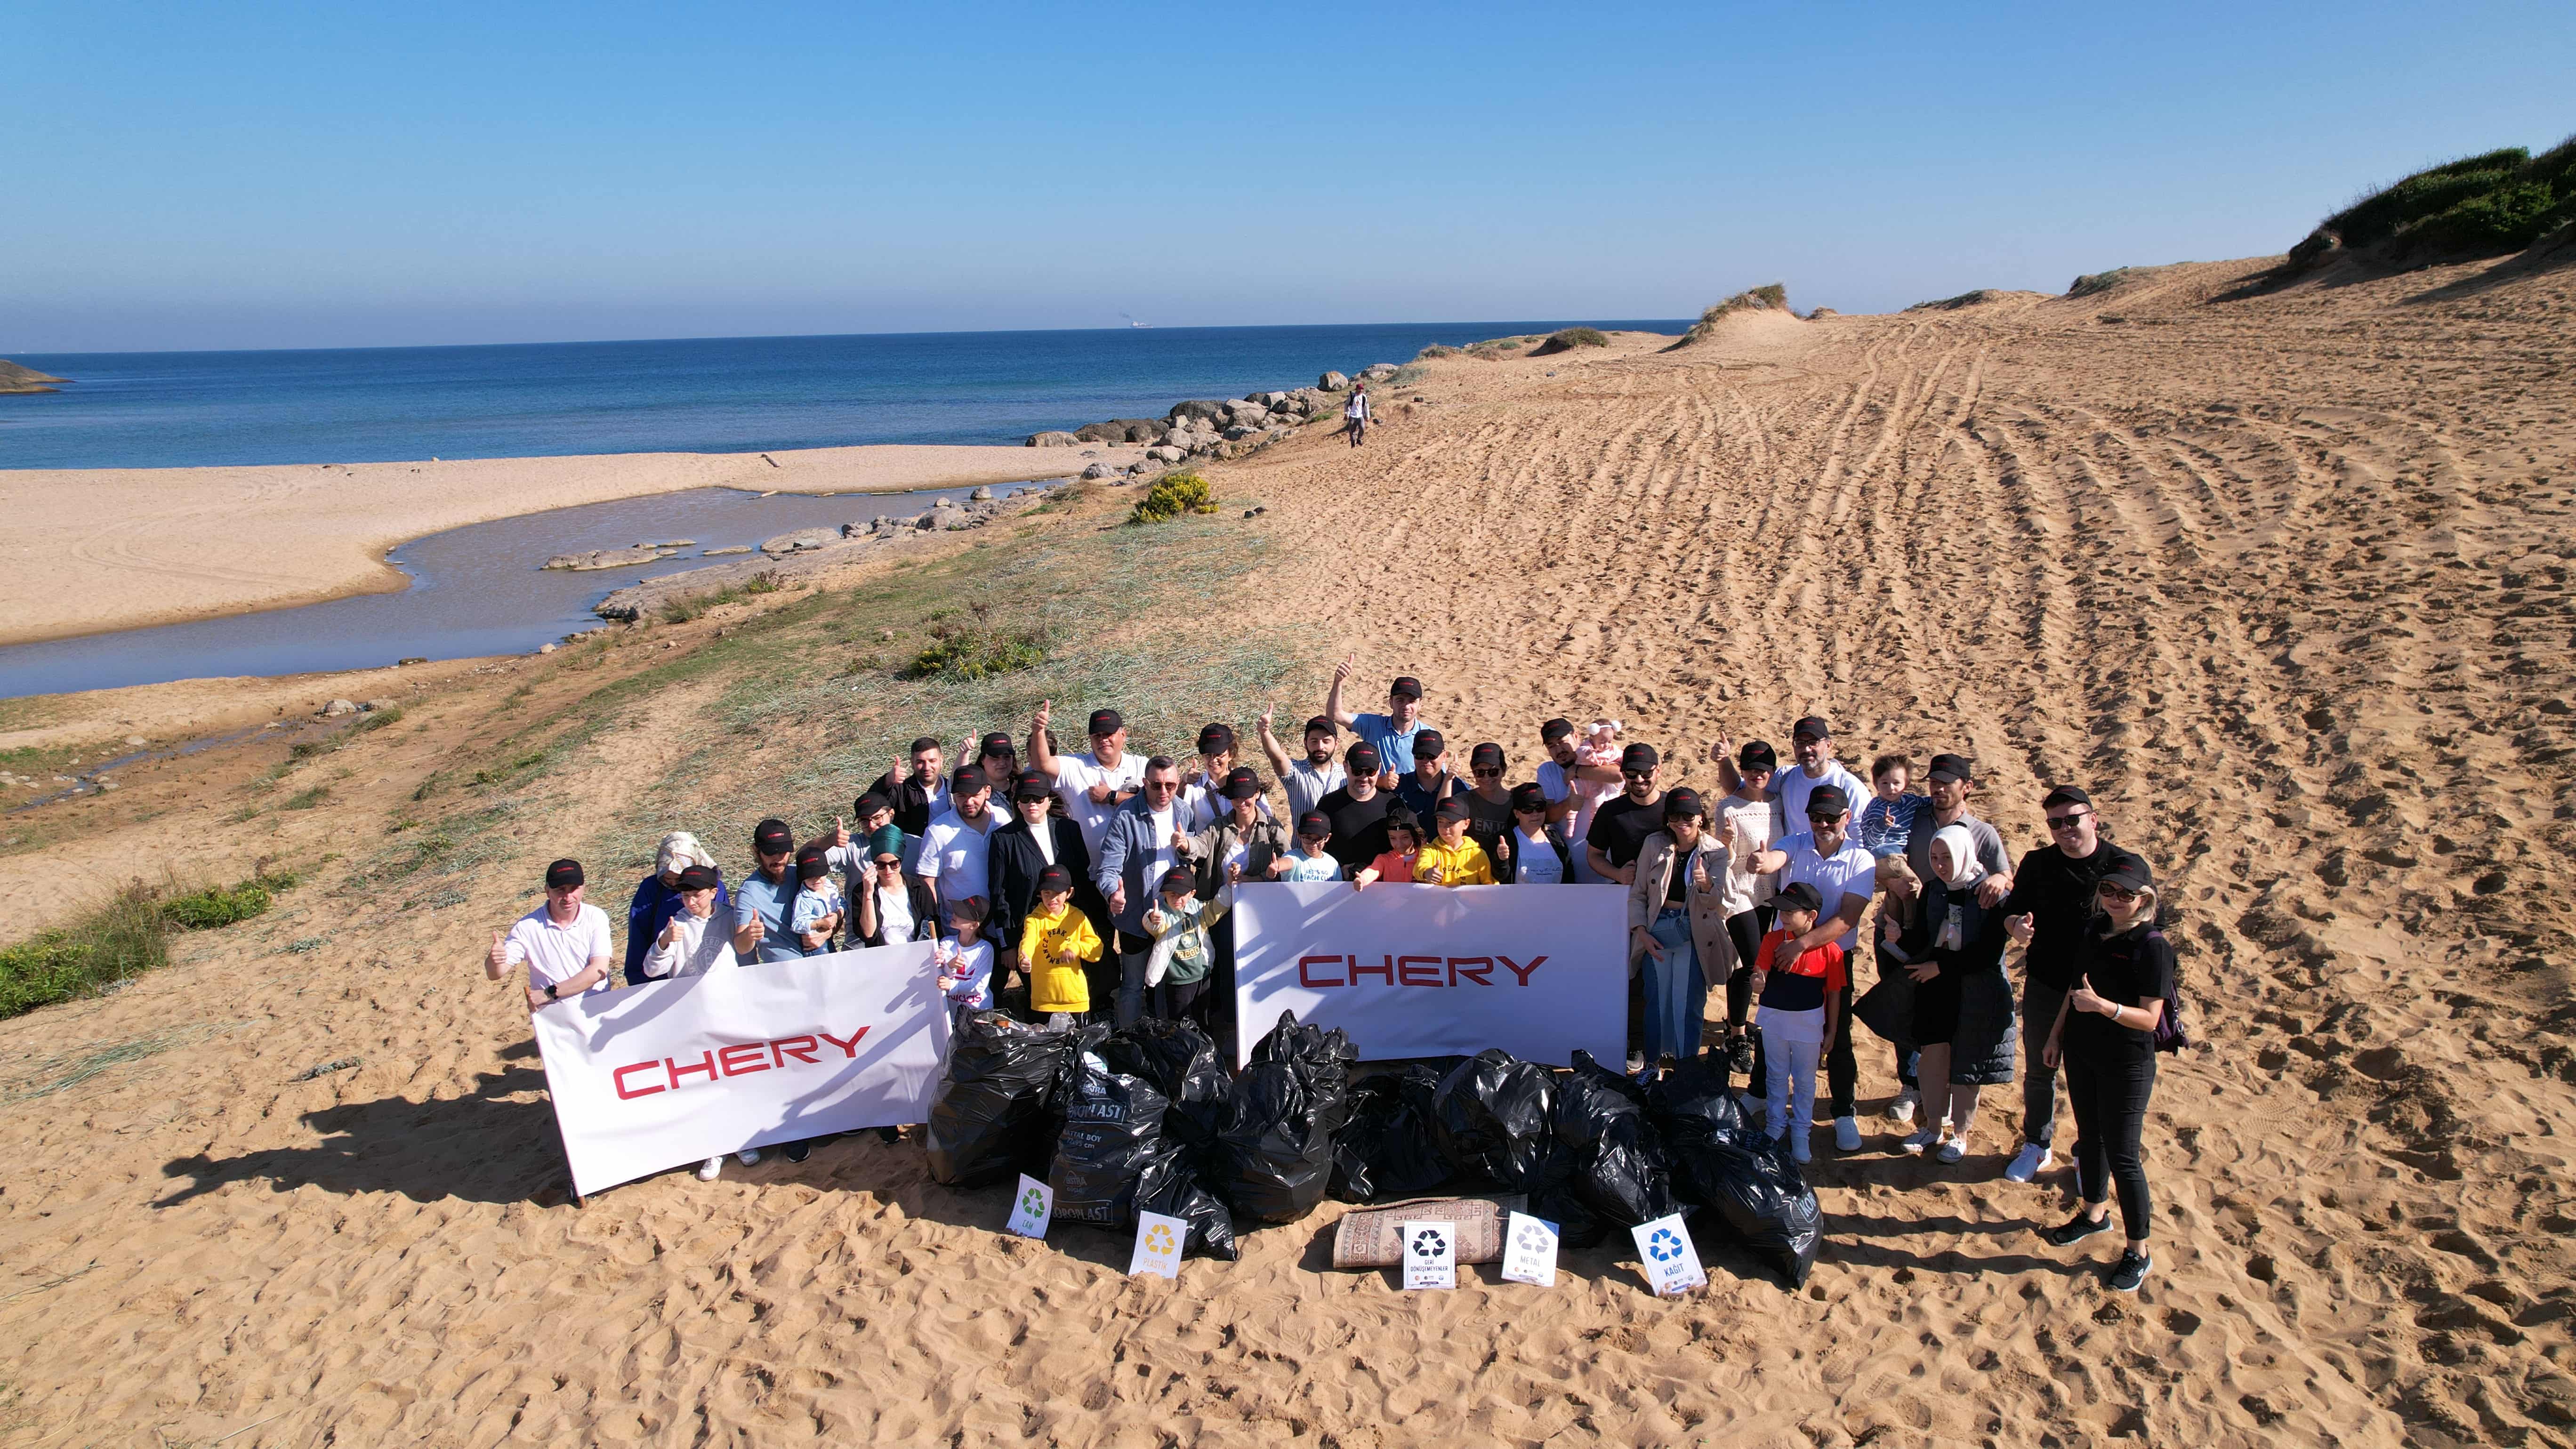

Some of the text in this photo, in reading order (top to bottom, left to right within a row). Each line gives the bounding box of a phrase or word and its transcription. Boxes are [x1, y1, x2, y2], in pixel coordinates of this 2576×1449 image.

[1047, 928, 1067, 937] PEAK
[1298, 955, 1550, 988] CHERY
[613, 1025, 871, 1101] CHERY
[1086, 1134, 1102, 1143] BOY
[1053, 1207, 1110, 1221] OROPLAST
[1520, 1255, 1540, 1267] METAL
[1664, 1263, 1684, 1277] KAĞIT
